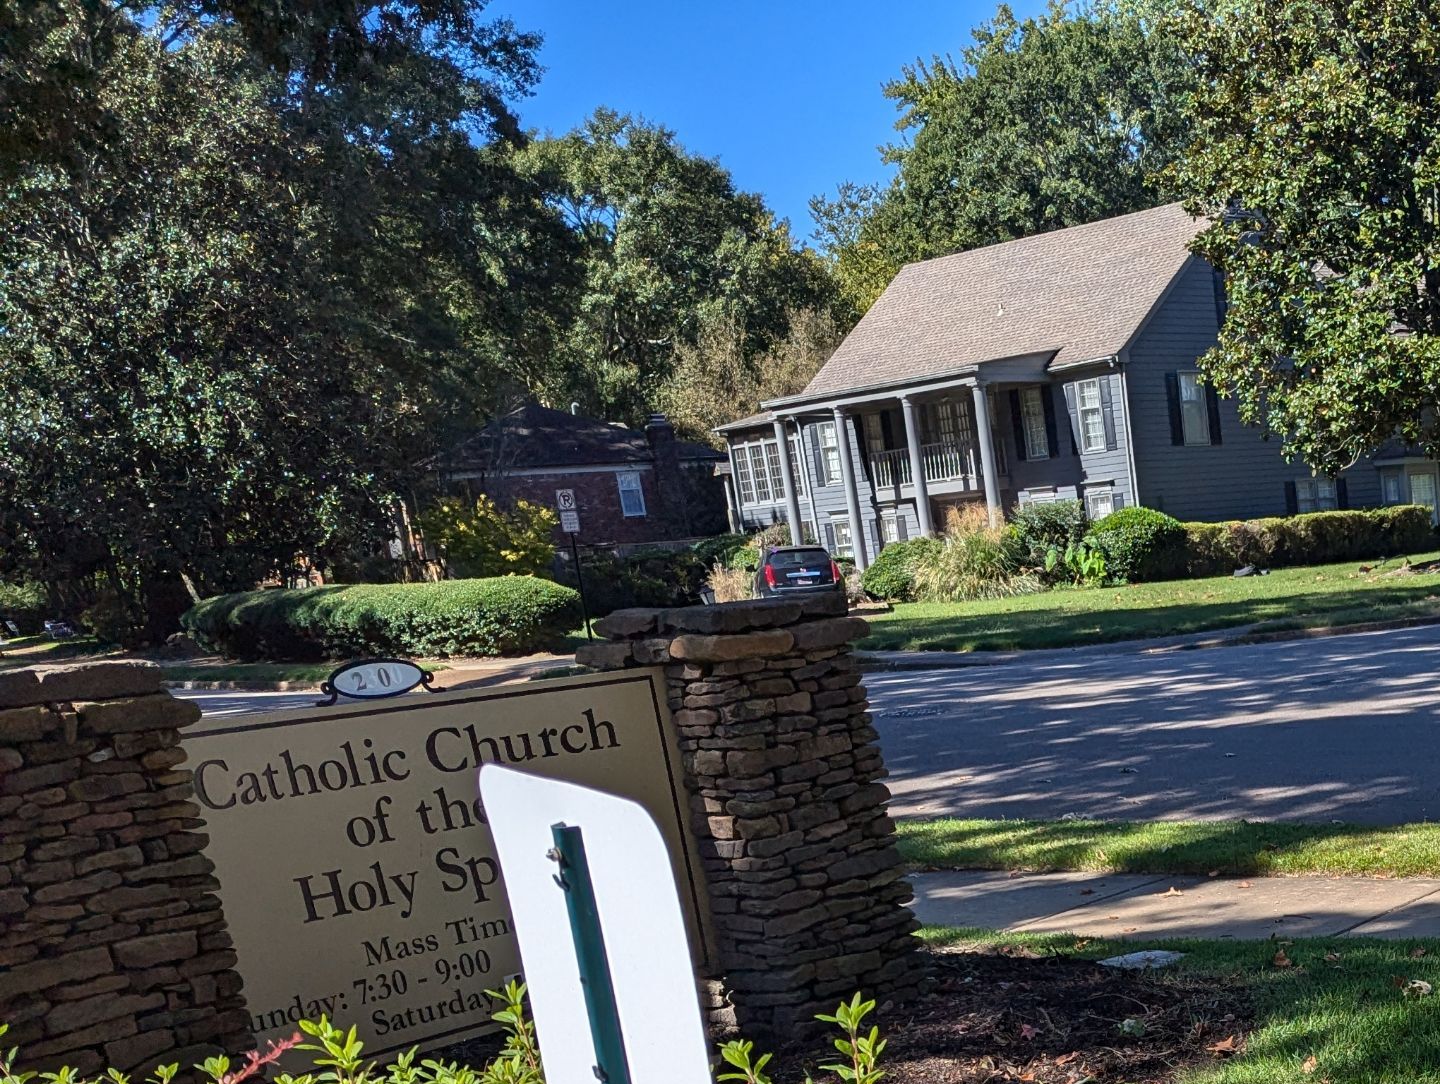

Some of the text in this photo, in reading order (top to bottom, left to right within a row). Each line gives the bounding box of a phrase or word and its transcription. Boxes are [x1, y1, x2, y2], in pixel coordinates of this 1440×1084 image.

[196, 708, 622, 811] Catholic Church
[345, 795, 397, 848] of
[292, 860, 419, 924] Holy
[361, 916, 516, 968] Mass Tim
[248, 992, 349, 1035] unday:
[353, 969, 408, 1005] 7:30
[435, 949, 491, 985] 9:00
